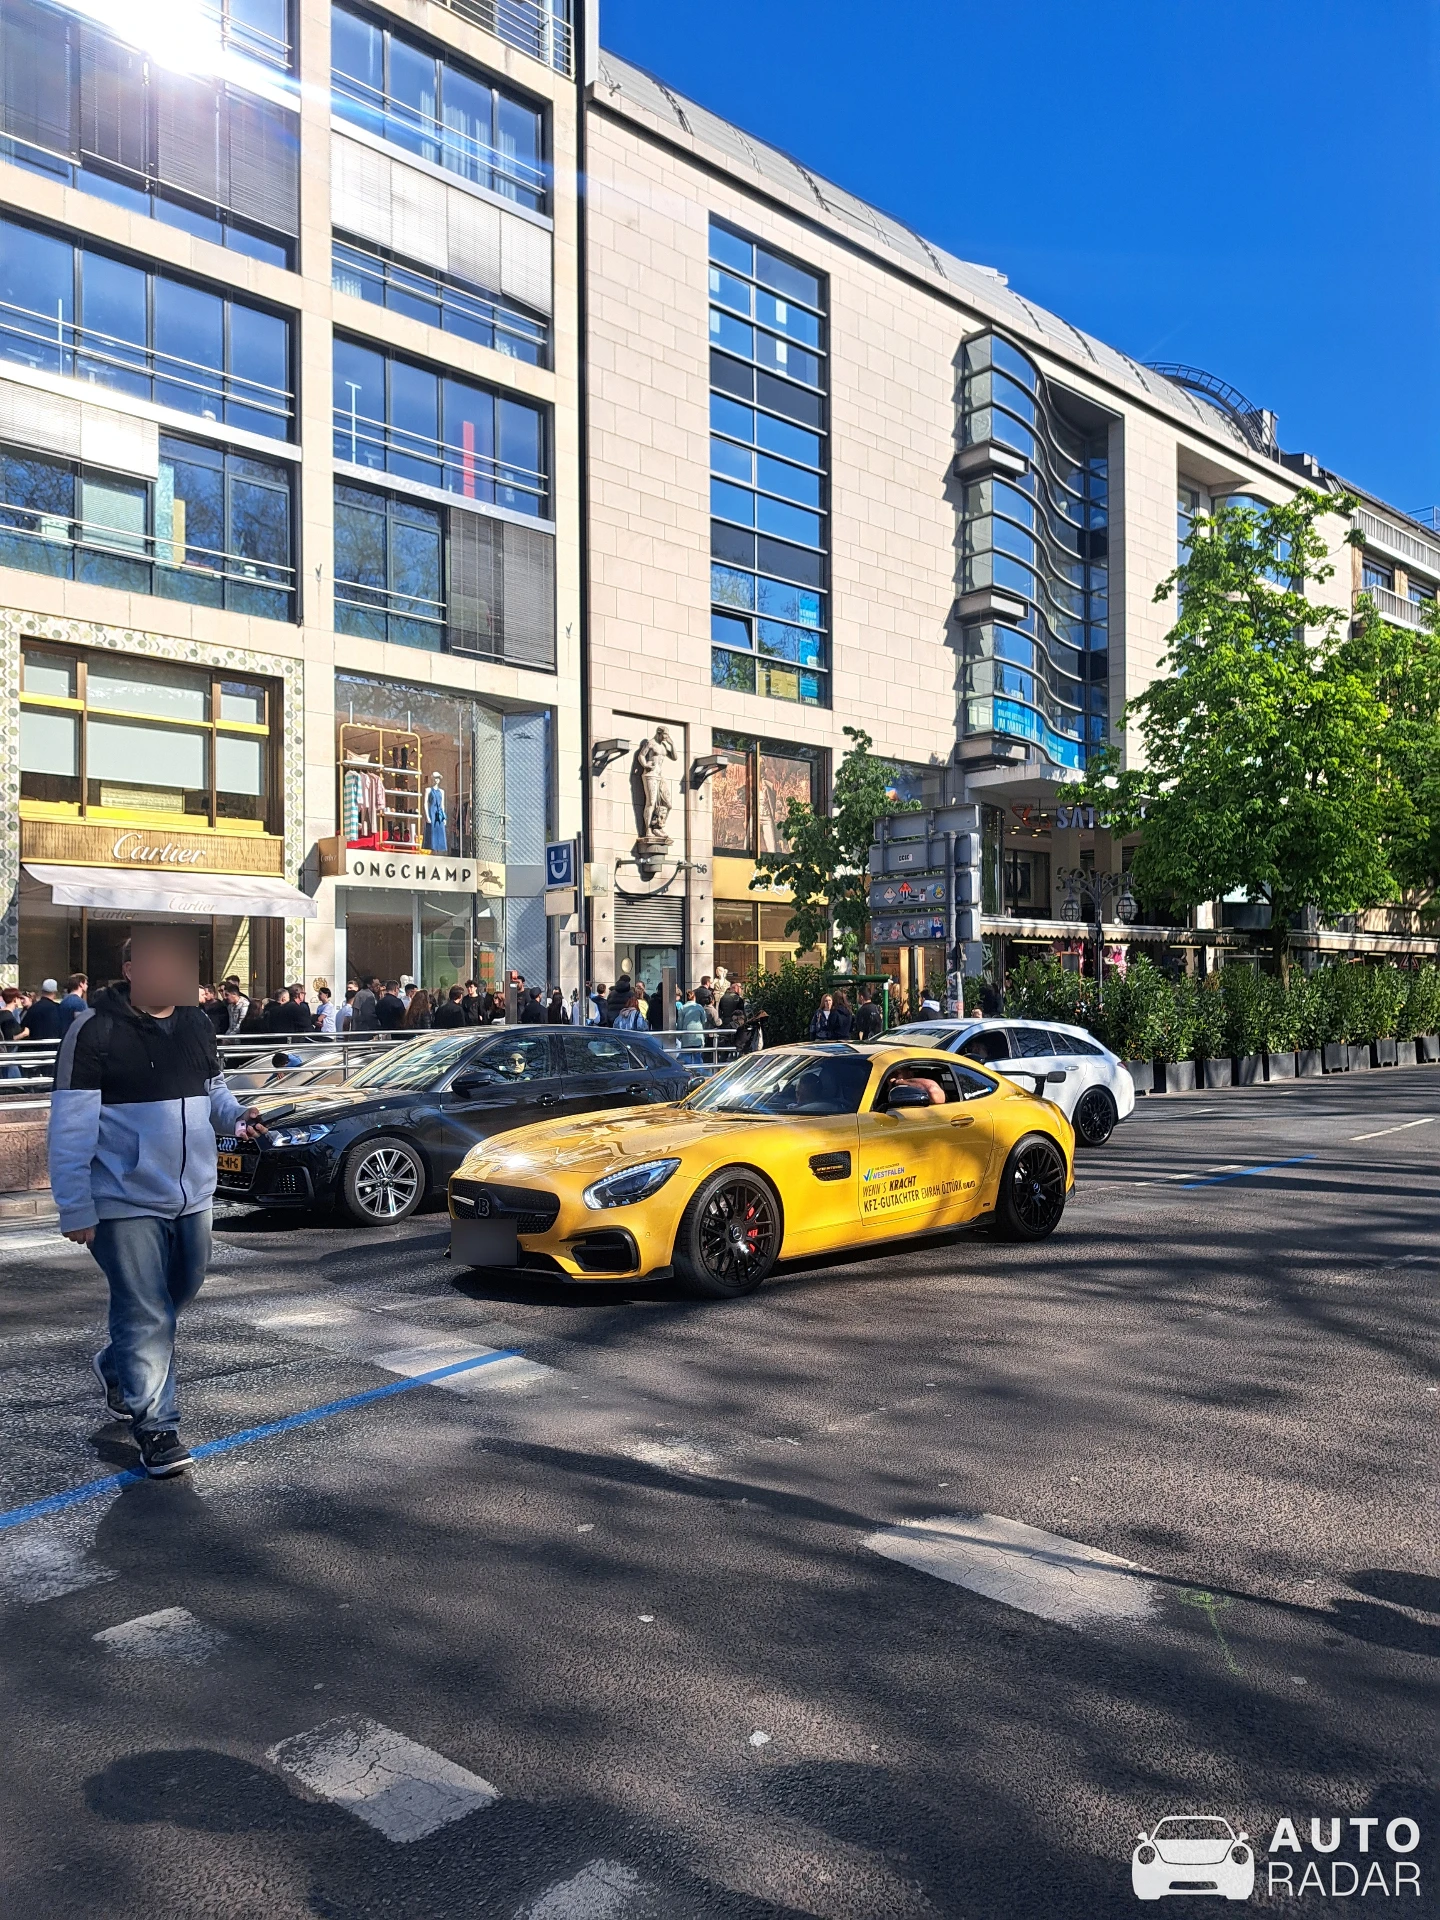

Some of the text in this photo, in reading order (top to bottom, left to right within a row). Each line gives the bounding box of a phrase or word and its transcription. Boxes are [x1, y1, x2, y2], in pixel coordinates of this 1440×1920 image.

[1056, 806, 1146, 829] SATU
[113, 832, 207, 863] Cartier
[353, 860, 472, 883] ONGCHAMP
[168, 895, 219, 913] Cartier
[872, 1166, 905, 1180] WESTFALEN
[889, 1175, 917, 1192] KRACHT
[863, 1189, 920, 1213] KFZ-GUTACHTER
